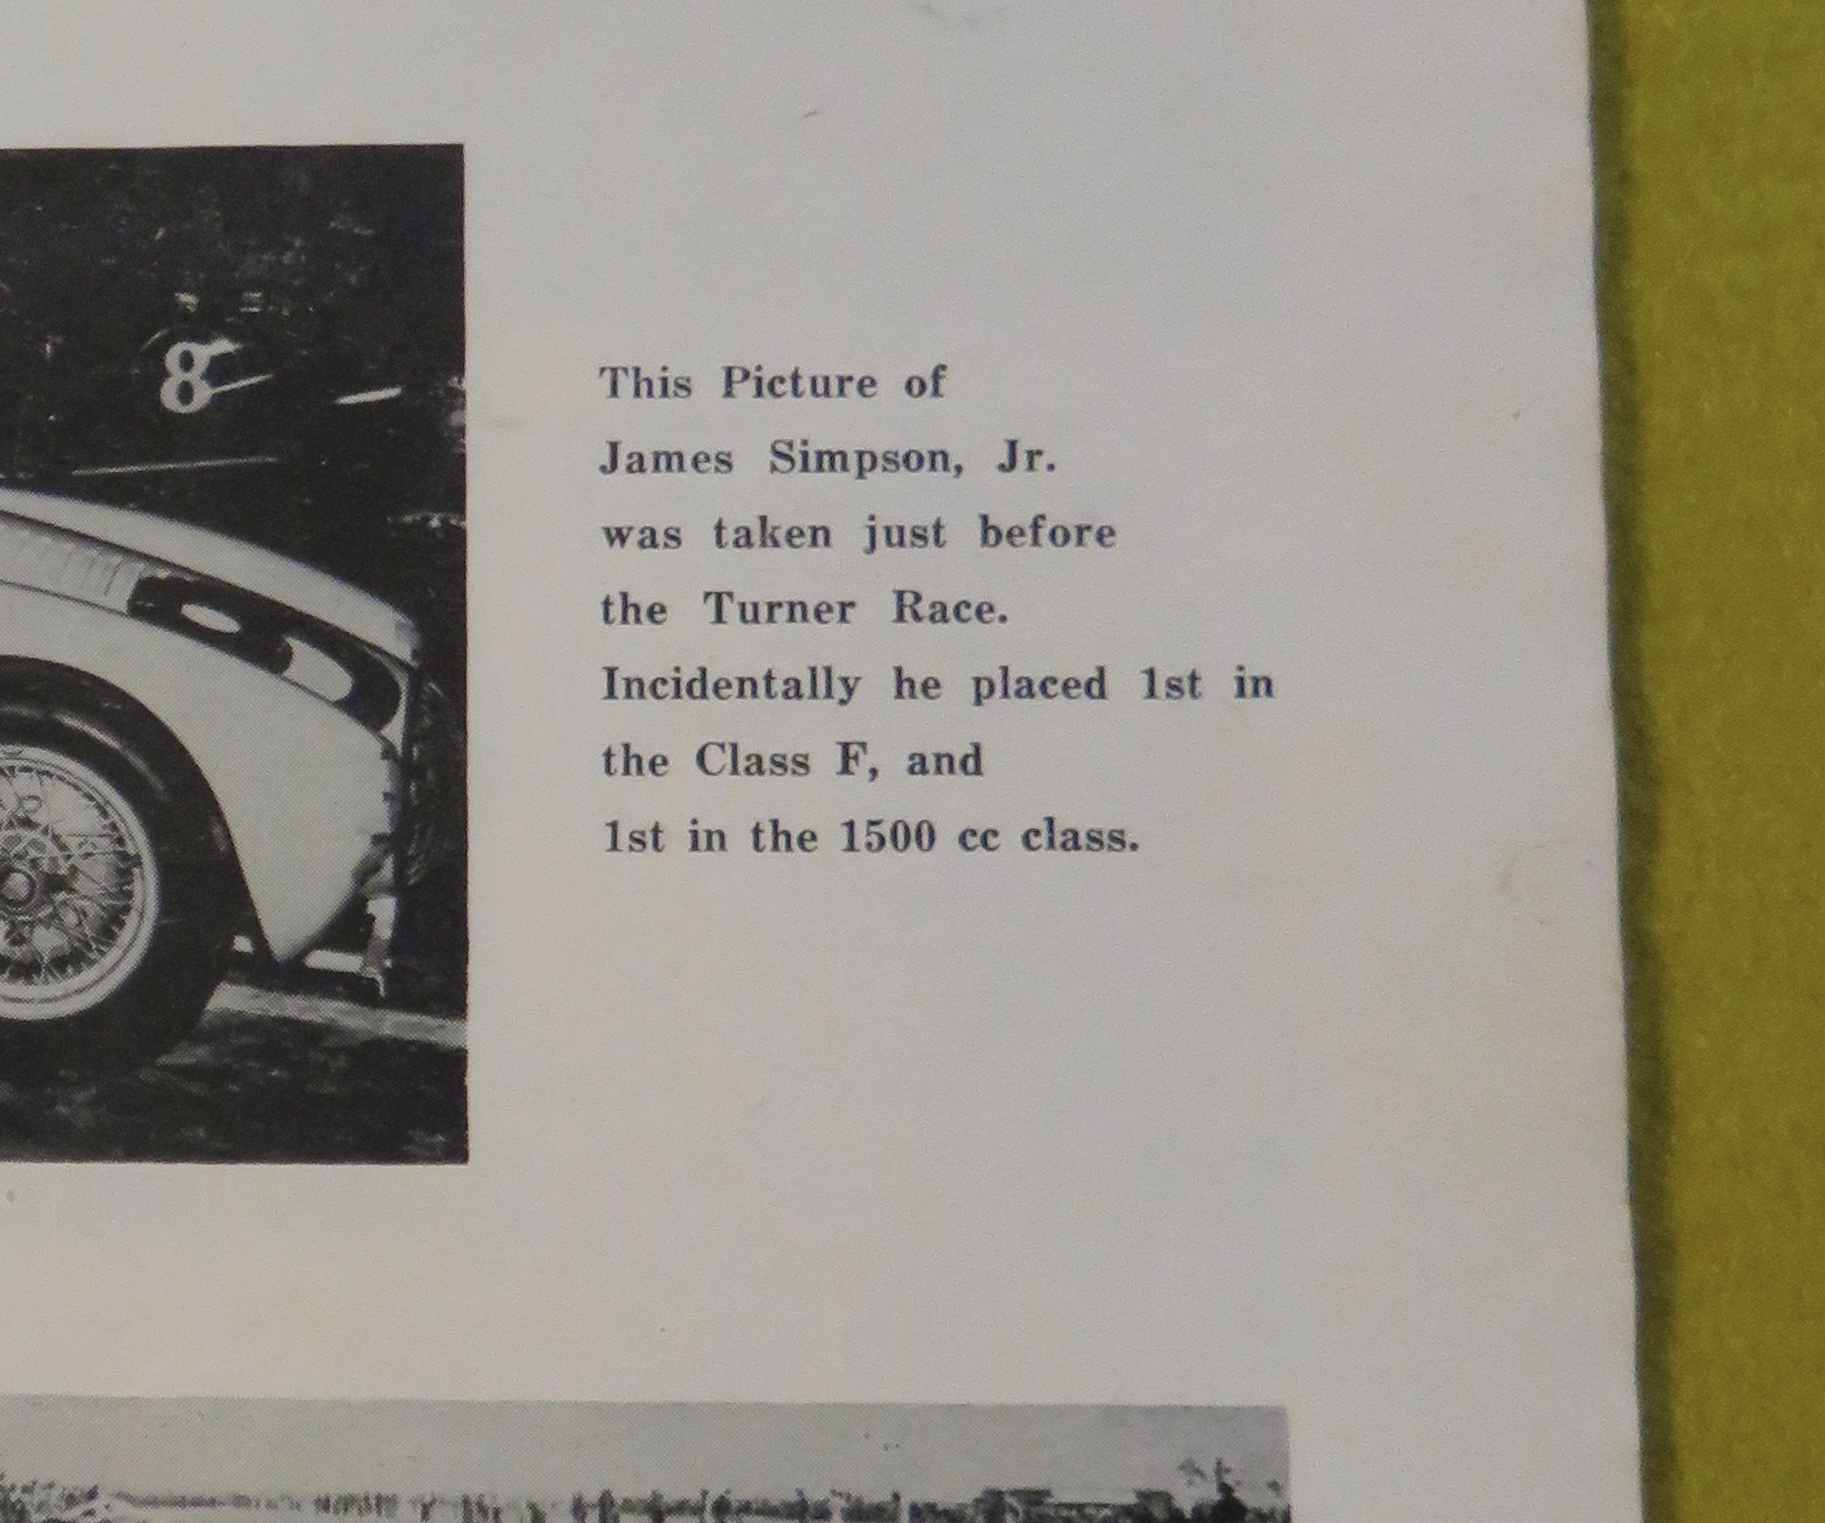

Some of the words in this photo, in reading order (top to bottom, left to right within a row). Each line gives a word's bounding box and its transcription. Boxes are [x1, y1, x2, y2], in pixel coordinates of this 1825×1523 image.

[599, 365, 693, 399] This
[722, 364, 878, 399] Picture
[904, 363, 948, 399] of
[599, 440, 734, 475] James
[770, 438, 964, 480] Simpson,
[997, 439, 1056, 473] Jr.
[602, 526, 683, 550] was
[713, 514, 831, 549] taken
[864, 514, 947, 555] just
[979, 513, 1116, 548] before
[601, 591, 668, 625] the
[703, 590, 857, 625] Turner
[893, 589, 1008, 625] Race.
[603, 665, 862, 706] Incidentally
[893, 665, 942, 700] he
[972, 665, 1108, 707] placed
[1143, 666, 1202, 700] 1st
[1235, 664, 1274, 699] in
[602, 742, 669, 777] the
[695, 741, 811, 777] Class
[837, 741, 879, 782] F,
[907, 741, 984, 777] and
[605, 820, 664, 853] 1st
[688, 817, 727, 852] in
[751, 818, 818, 853] the
[842, 819, 937, 853] 1500
[957, 827, 1000, 852] cc
[1021, 815, 1139, 852] class.
